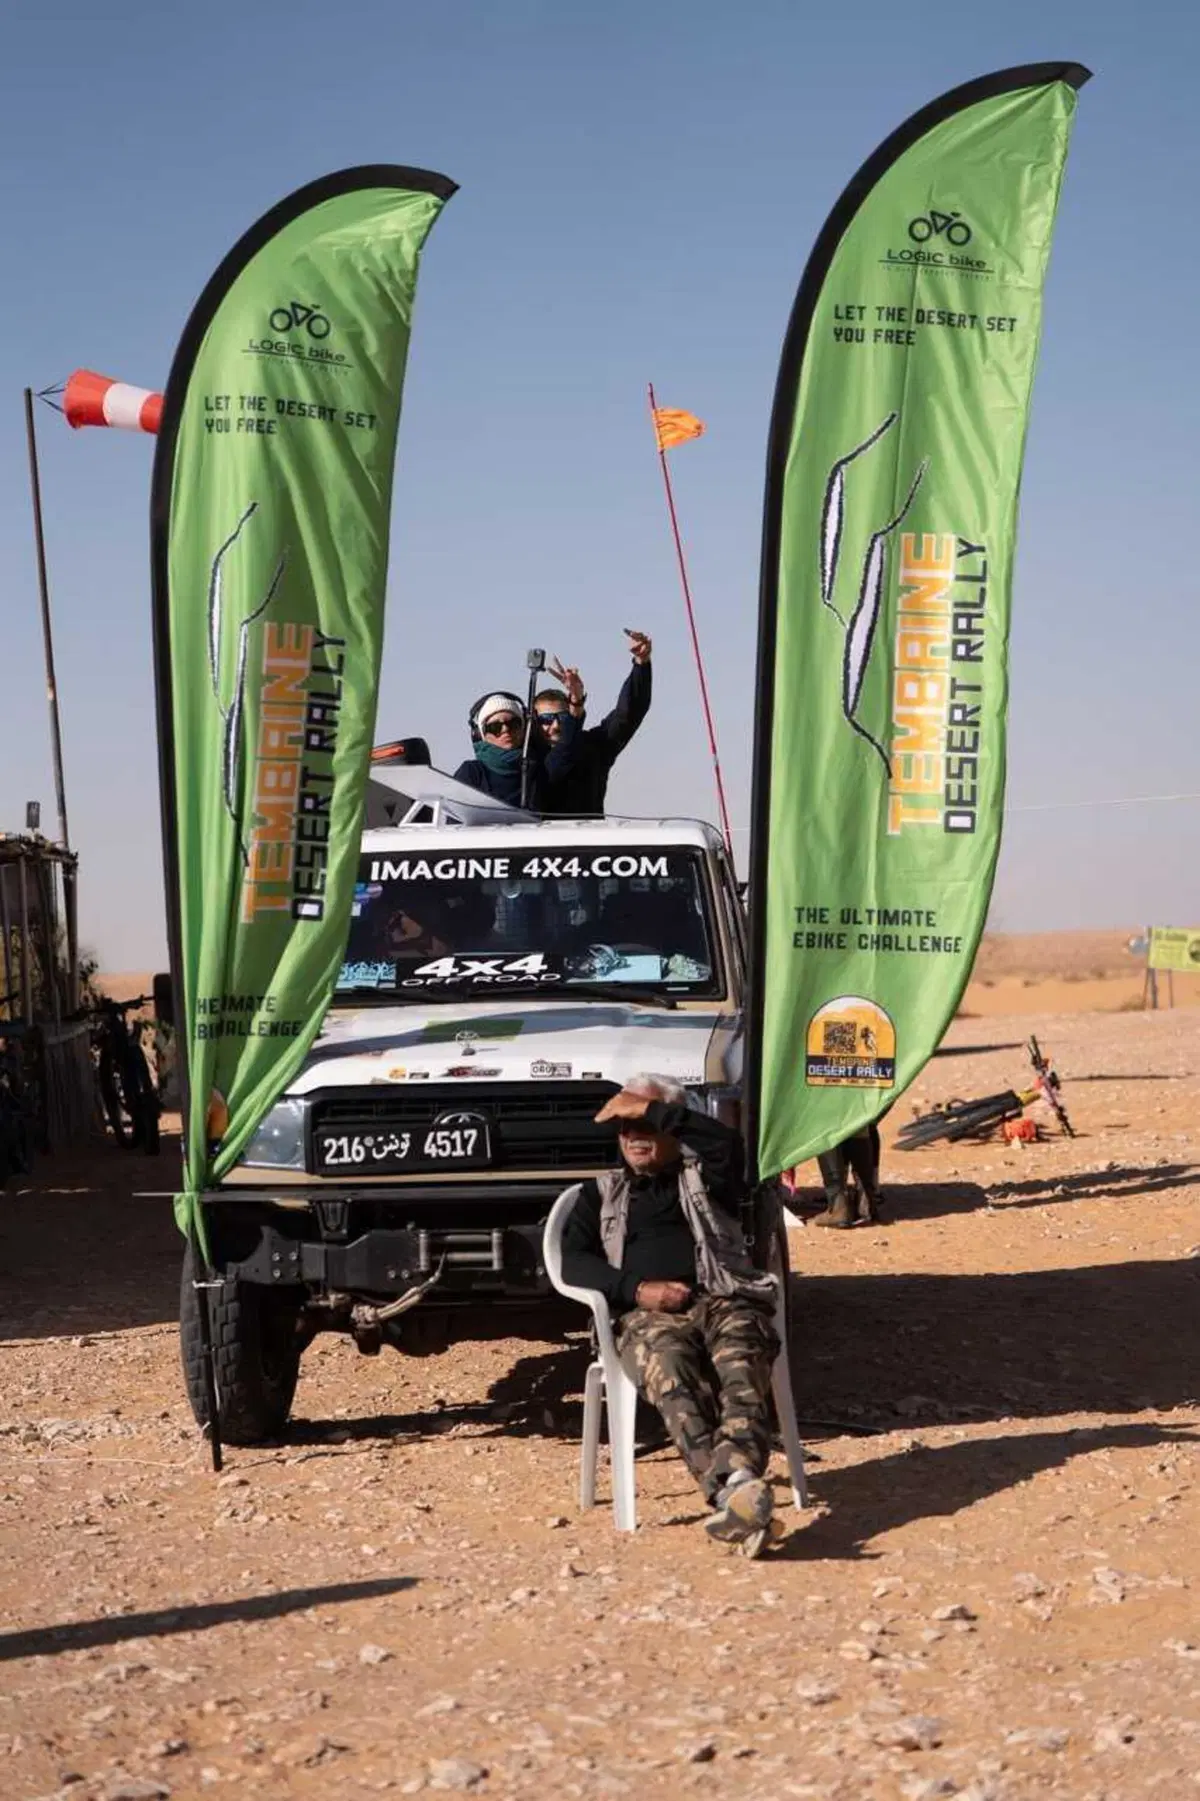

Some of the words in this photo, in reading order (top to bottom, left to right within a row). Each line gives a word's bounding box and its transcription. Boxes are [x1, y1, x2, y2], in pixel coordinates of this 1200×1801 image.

[887, 248, 945, 264] LOGIC
[949, 254, 988, 269] bike
[834, 304, 867, 321] LET
[876, 306, 907, 322] THE
[915, 308, 978, 329] DESERT
[986, 316, 1018, 332] SET
[248, 339, 305, 356] LOGIC
[308, 346, 346, 362] bike
[833, 327, 865, 343] YOU
[874, 328, 916, 346] FREE
[204, 396, 231, 412] LET
[239, 396, 268, 412] THE
[275, 399, 337, 423] DESERT
[344, 411, 377, 429] SET
[204, 418, 231, 434] YOU
[237, 418, 277, 434] FREE
[952, 537, 987, 663] RALLY
[303, 628, 346, 751] RALLY
[887, 532, 956, 835] TEMBAINE
[944, 677, 982, 834] DESERT
[241, 622, 314, 923] TEMBAINE
[291, 766, 334, 921] DESERT
[370, 857, 510, 882] IMAGINE
[522, 856, 669, 879] 4X4.COM
[795, 907, 830, 925] THE
[840, 908, 936, 927] ULTIMATE
[793, 932, 847, 950] EBIKE
[858, 933, 963, 953] CHALLENGE
[401, 976, 460, 987] OFF
[473, 973, 562, 983] ROAD
[808, 1064, 854, 1076] DESERT
[856, 1065, 892, 1078] RALLY
[324, 1136, 366, 1165] 216
[424, 1129, 478, 1158] 4517
